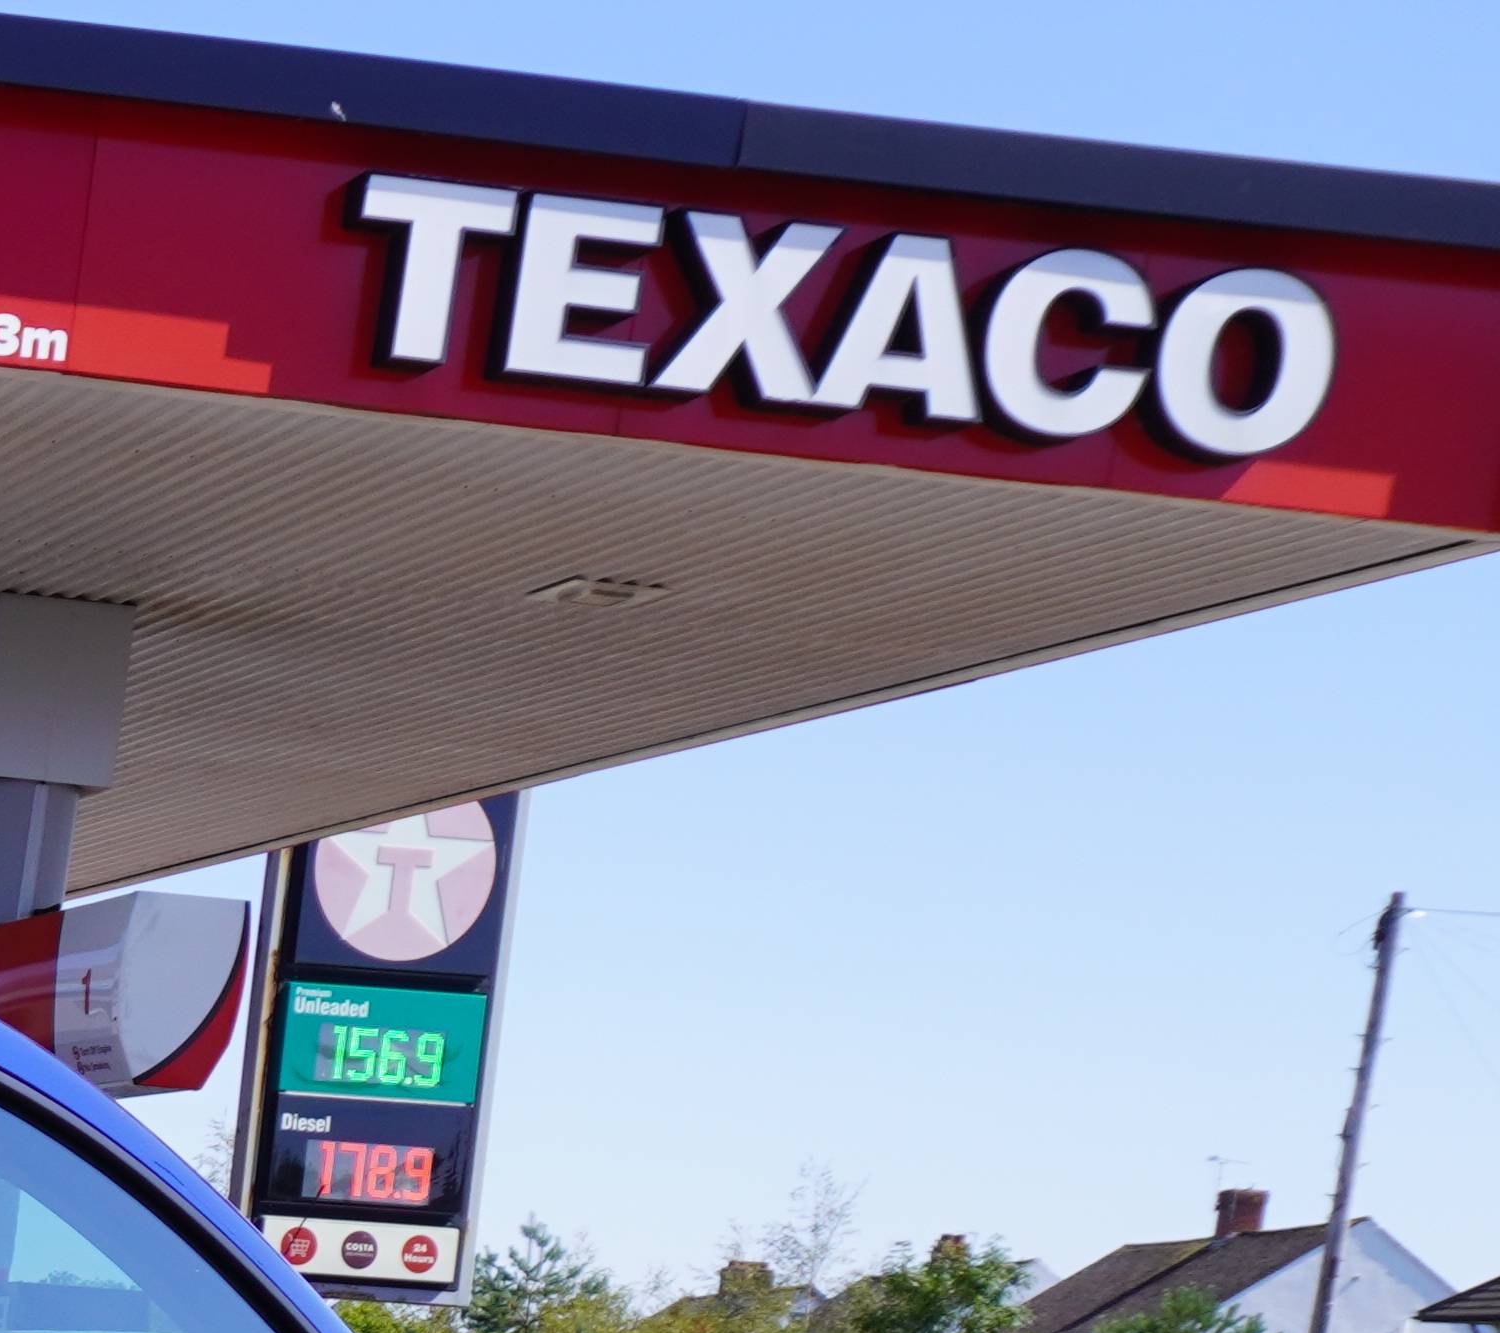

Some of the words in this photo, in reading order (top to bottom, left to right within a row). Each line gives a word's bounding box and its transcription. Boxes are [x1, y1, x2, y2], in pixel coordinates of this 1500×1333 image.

[360, 173, 1335, 455] TEXACO
[293, 996, 370, 1018] Unleaded
[332, 1025, 445, 1088] 156.9
[280, 1112, 332, 1133] Diesel
[317, 1139, 435, 1201] 178.9
[346, 1242, 374, 1253] COSTA
